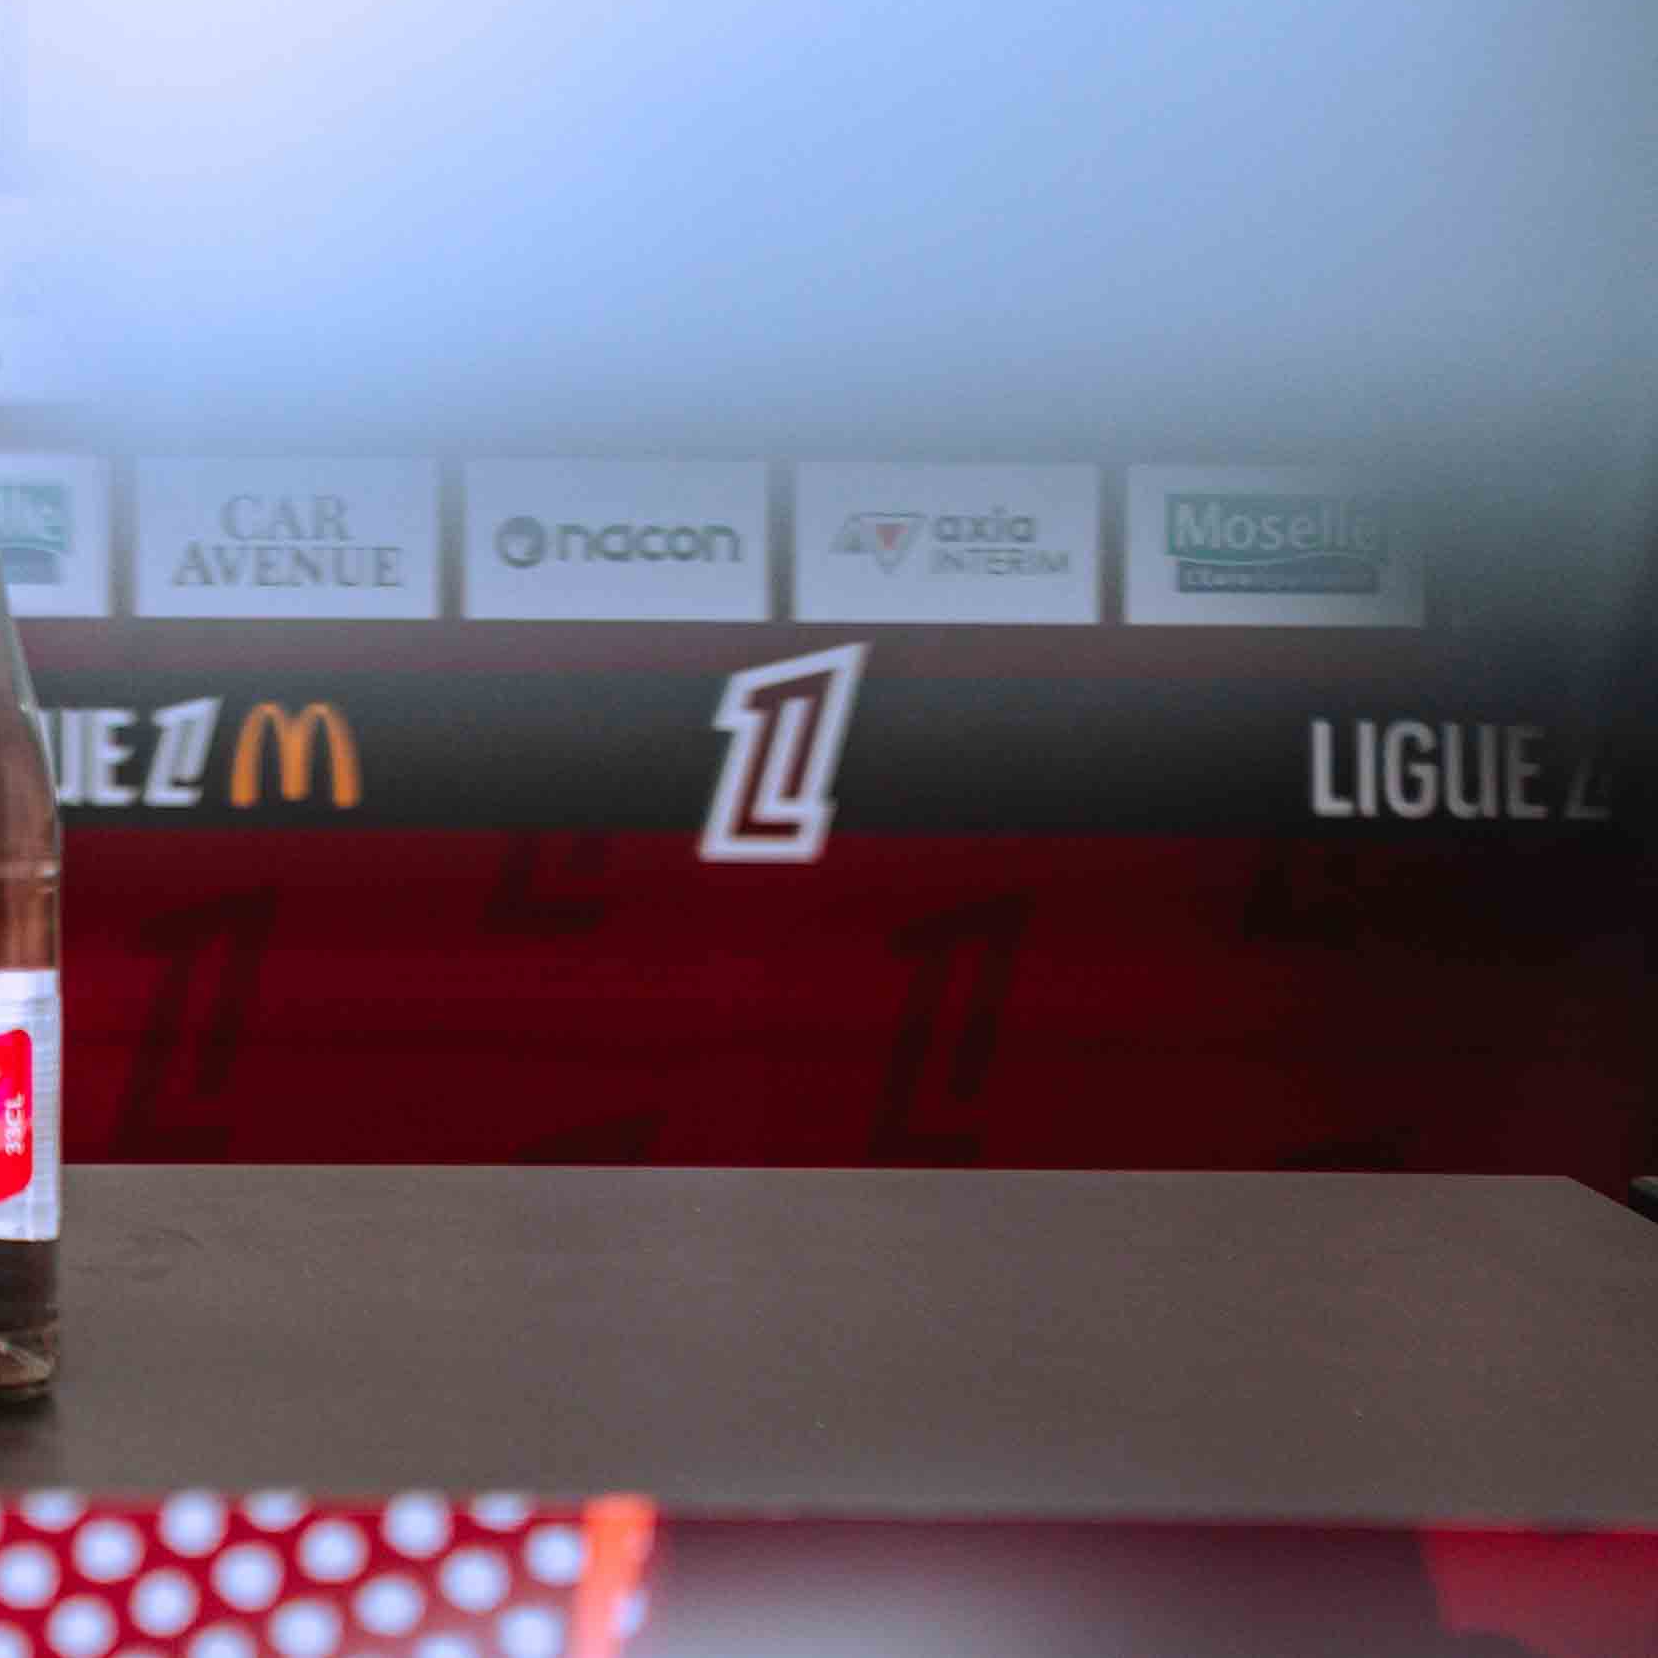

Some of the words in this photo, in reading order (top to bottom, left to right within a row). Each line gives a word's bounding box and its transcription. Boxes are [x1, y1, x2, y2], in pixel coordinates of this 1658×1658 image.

[222, 494, 355, 541] CAR
[937, 509, 1035, 543] axia
[558, 519, 742, 562] nacon
[931, 548, 1070, 576] INTERIM
[174, 544, 406, 588] AVENUE
